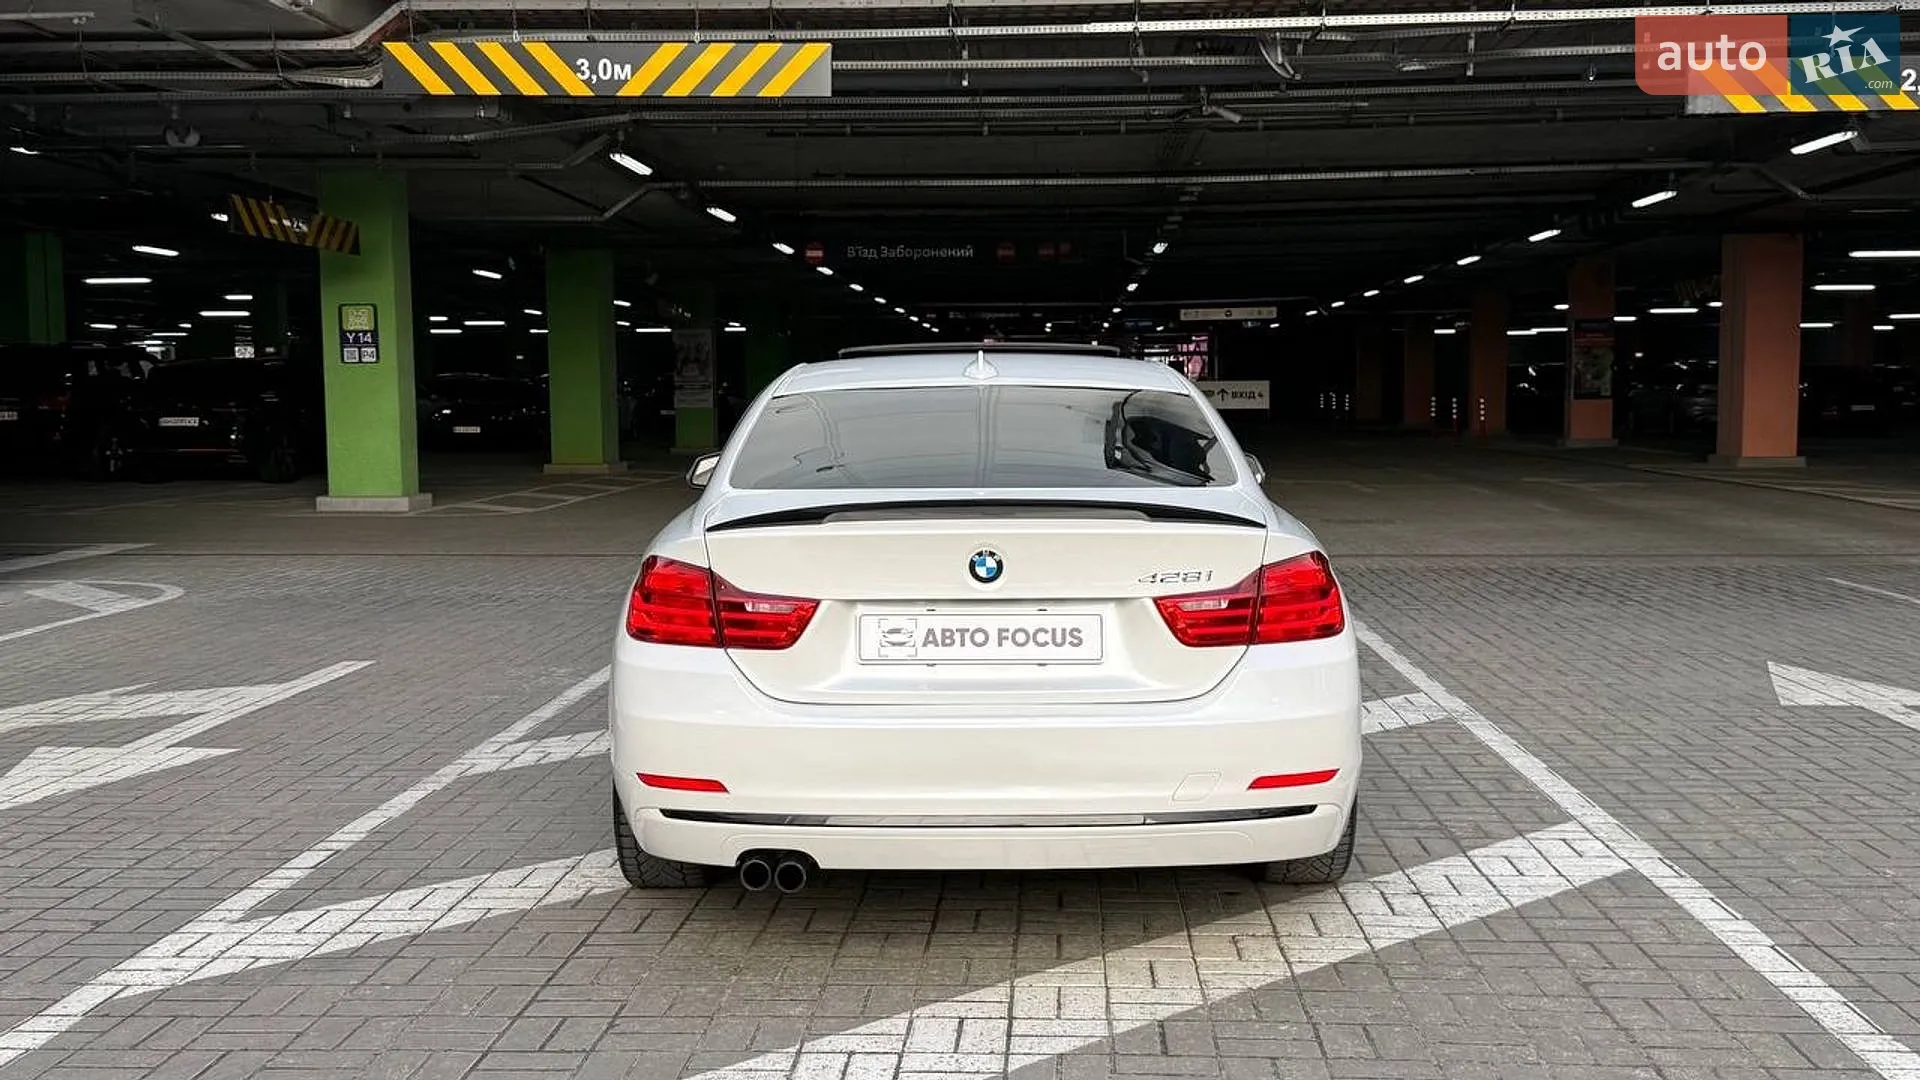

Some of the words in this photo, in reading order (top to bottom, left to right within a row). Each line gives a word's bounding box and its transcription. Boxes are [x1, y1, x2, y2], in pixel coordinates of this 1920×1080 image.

[880, 244, 974, 261] Заборонений
[1137, 569, 1213, 584] 428i
[997, 627, 1084, 648] FOCUS
